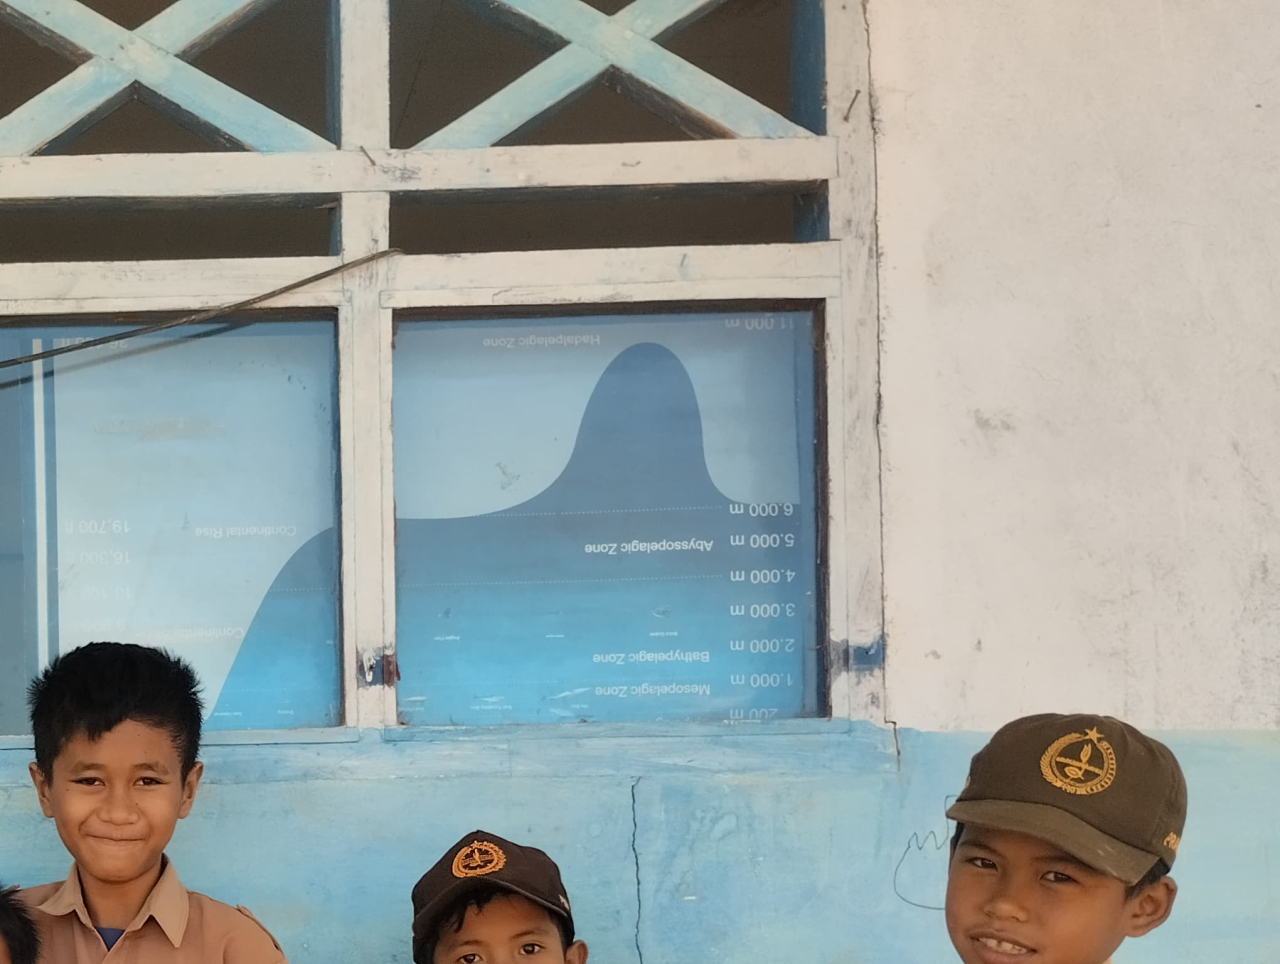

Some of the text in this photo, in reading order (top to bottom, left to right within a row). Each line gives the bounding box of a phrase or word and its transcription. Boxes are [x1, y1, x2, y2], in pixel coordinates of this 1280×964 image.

[724, 317, 741, 328] m
[482, 333, 601, 349] Hadalpelagic Zone
[729, 502, 794, 517] 6.000 m
[194, 524, 298, 539] Continental Rise
[584, 537, 714, 555] Abyssopelagic Zone
[729, 532, 795, 549] 5.000 m
[729, 569, 796, 585] 4.000 m
[729, 602, 796, 619] 3.000 m
[729, 638, 795, 654] 2.000 m
[592, 649, 710, 665] Bathypelagic Zone
[730, 673, 794, 688] 1.000 m
[594, 682, 711, 698] Mesopelagic Zone
[729, 708, 745, 720] m
